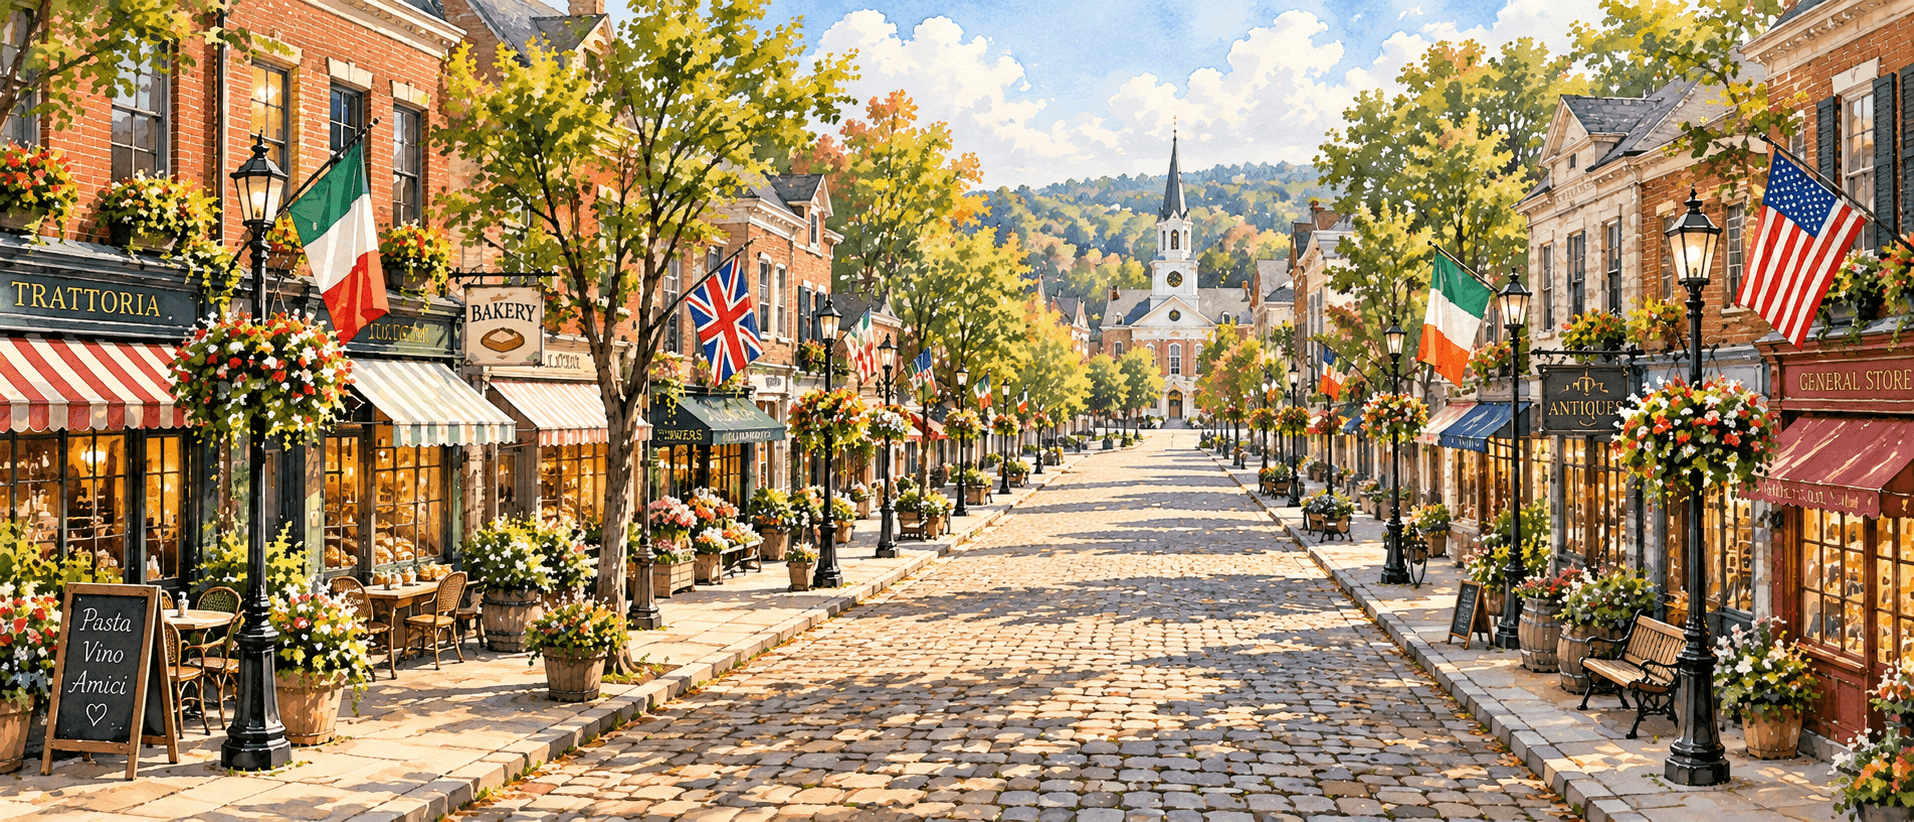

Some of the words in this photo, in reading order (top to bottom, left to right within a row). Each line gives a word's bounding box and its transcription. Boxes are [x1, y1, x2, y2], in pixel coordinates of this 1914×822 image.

[11, 281, 161, 317] TRATTORIA
[471, 302, 537, 322] BAKERY
[1799, 372, 1860, 391] GENERAL
[1866, 369, 1912, 390] STORE
[79, 607, 132, 632] Pasta
[83, 640, 124, 663] Vino
[68, 670, 128, 694] Amici
